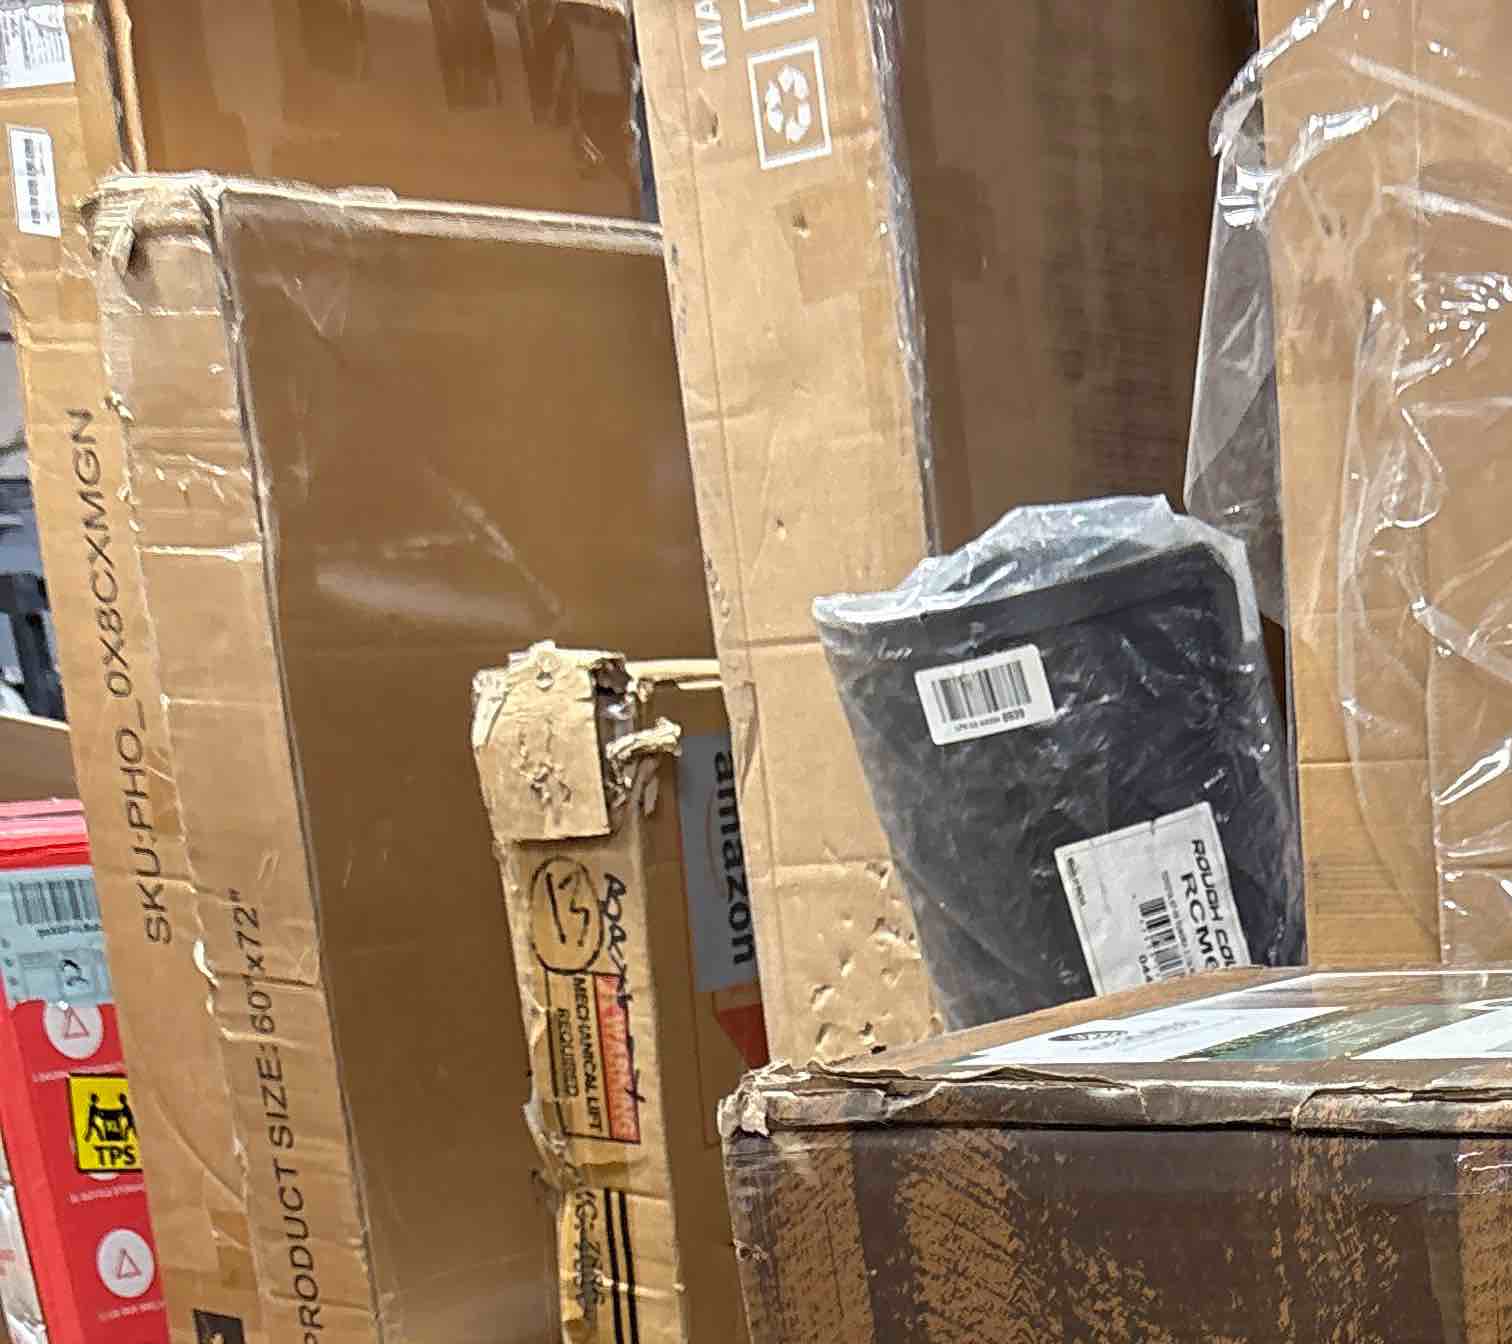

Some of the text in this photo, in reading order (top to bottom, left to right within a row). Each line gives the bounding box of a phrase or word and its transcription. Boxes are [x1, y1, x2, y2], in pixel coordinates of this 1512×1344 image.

[714, 750, 756, 966] amazon
[1192, 839, 1224, 922] ROUGH
[573, 976, 598, 1093] MECHANICAL
[94, 1144, 137, 1167] TPS
